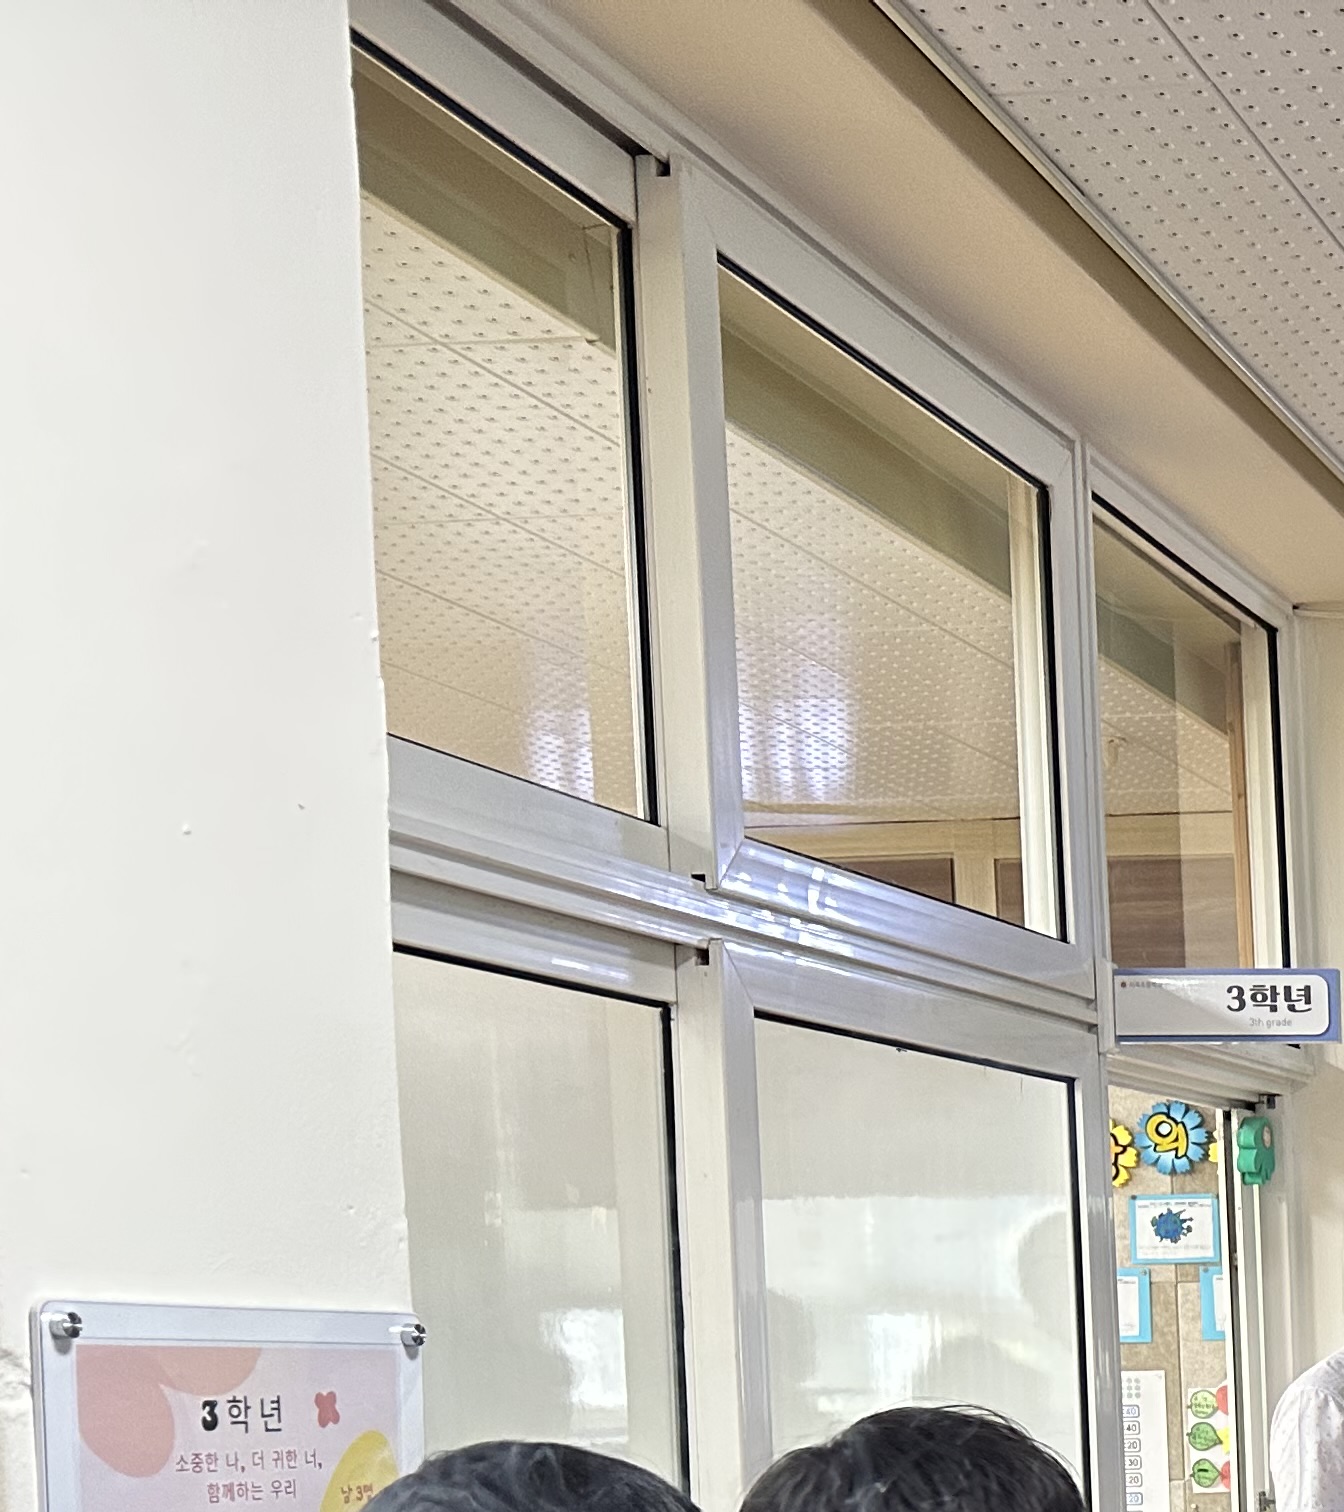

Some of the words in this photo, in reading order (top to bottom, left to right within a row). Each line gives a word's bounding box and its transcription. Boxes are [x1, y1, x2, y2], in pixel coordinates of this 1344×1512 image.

[1226, 984, 1313, 1014] 3학년
[201, 1395, 284, 1434] 3학년
[175, 1452, 219, 1474] 소중한
[225, 1450, 246, 1473] 나,
[252, 1450, 265, 1470] 더
[271, 1449, 298, 1470] 귀한
[304, 1448, 323, 1470] 너,
[206, 1481, 265, 1504] 함께하는
[270, 1479, 297, 1500] 우리
